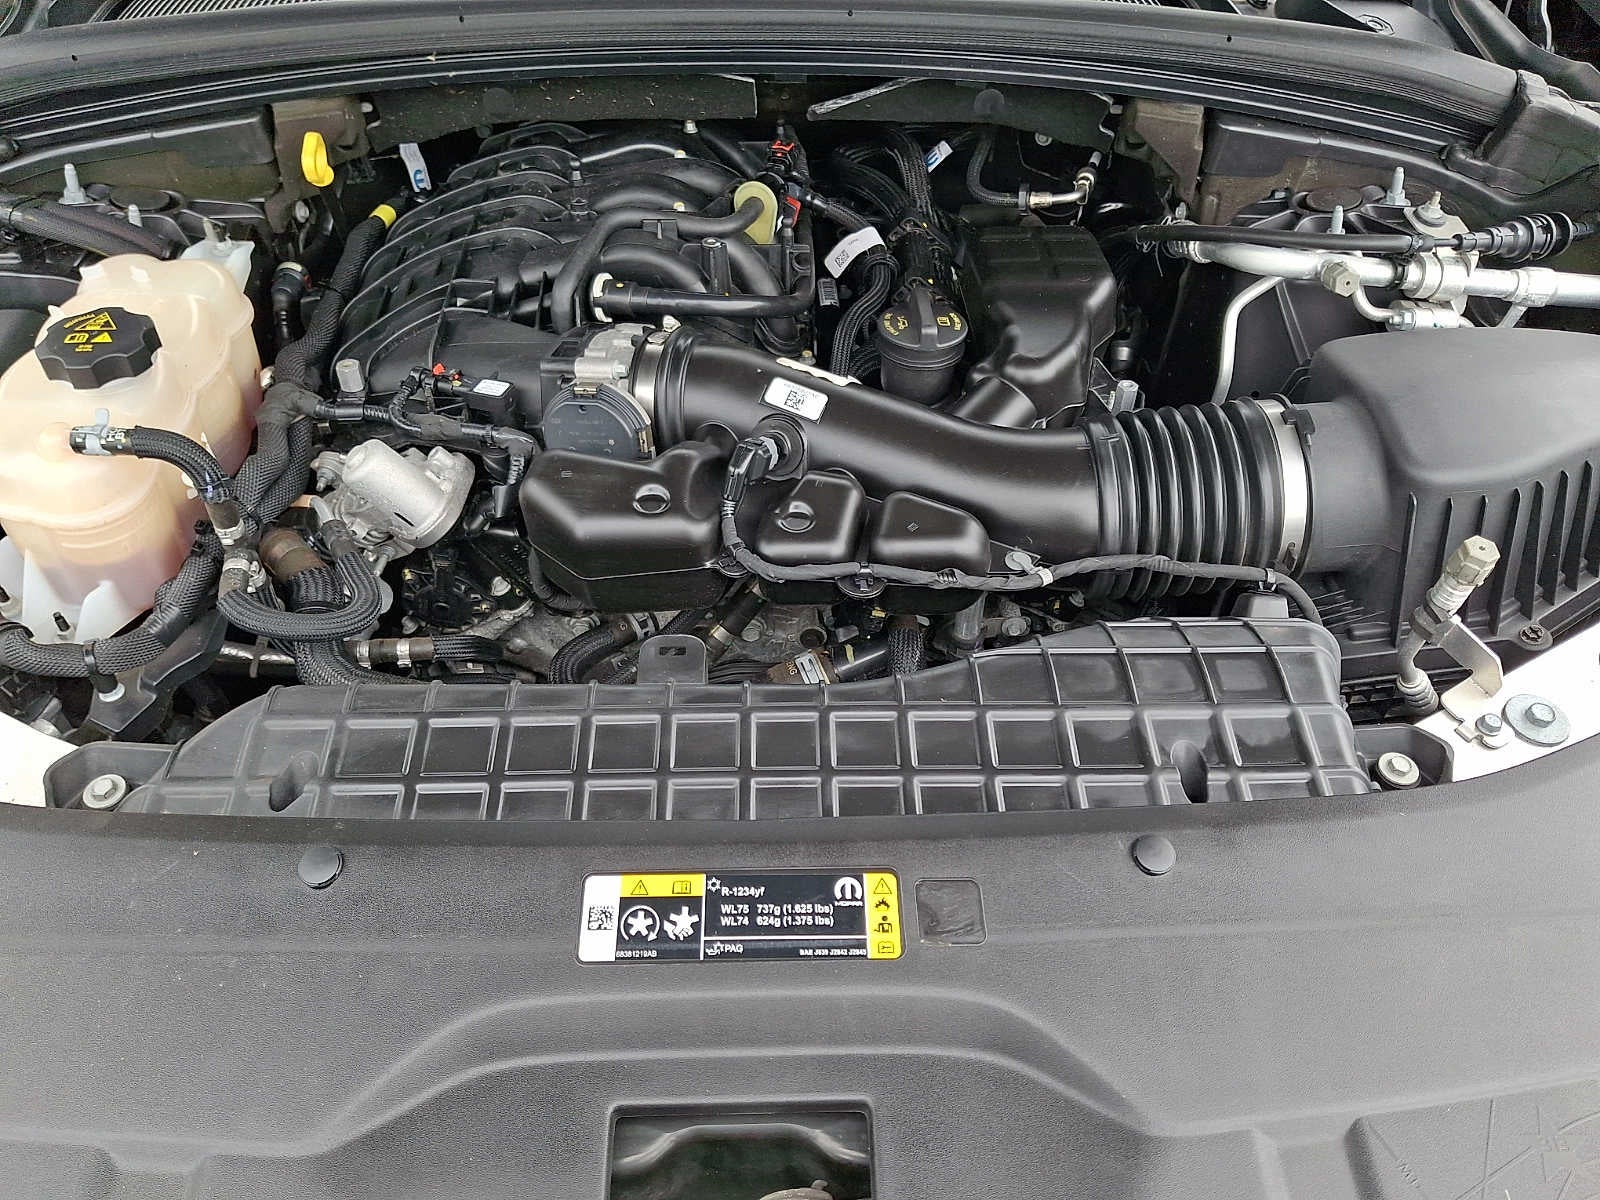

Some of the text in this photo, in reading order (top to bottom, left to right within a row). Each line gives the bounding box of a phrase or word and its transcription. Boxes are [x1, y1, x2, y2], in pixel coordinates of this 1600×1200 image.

[721, 887, 765, 898] R-1234yf
[720, 903, 834, 917] WL75 737g (1.625 lbs)
[720, 915, 834, 927] WL74 624g (1.375 lbs)
[724, 943, 744, 954] PAG
